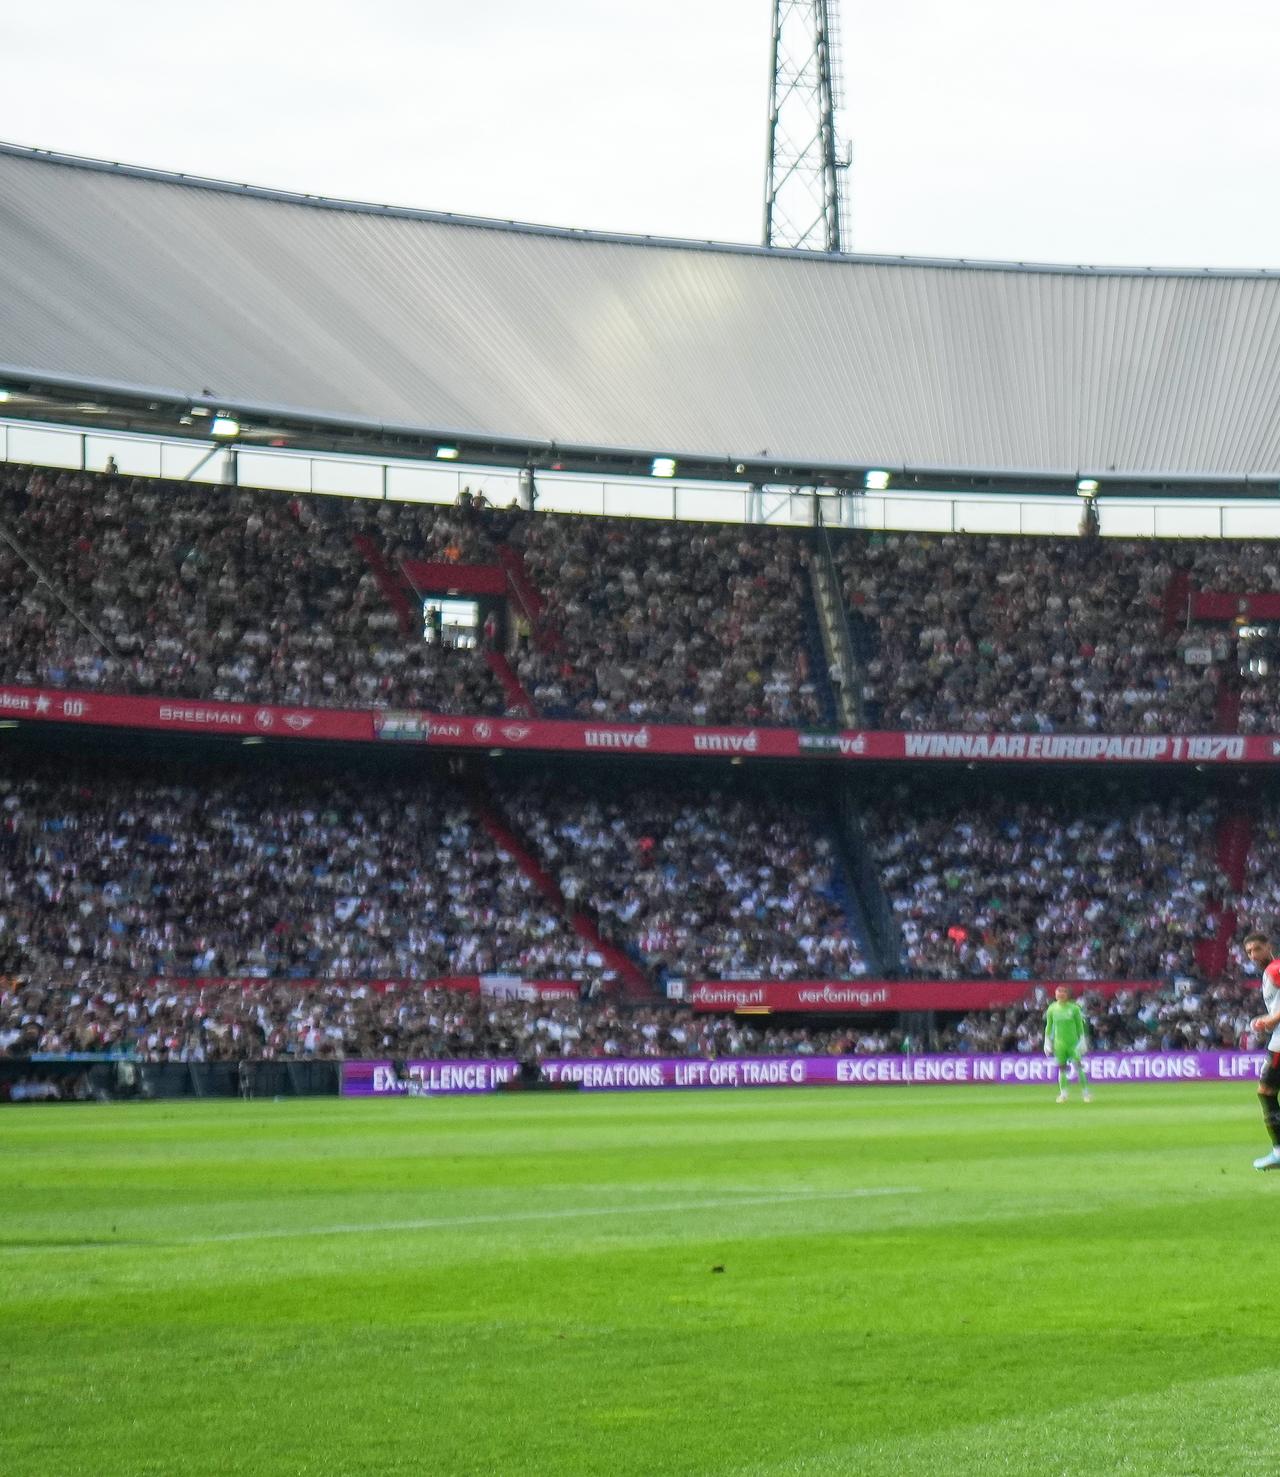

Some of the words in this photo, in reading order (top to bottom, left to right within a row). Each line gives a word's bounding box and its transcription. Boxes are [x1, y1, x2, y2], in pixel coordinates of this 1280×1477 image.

[160, 707, 242, 724] BREEMAN
[584, 728, 648, 748] univé
[693, 731, 757, 751] univé
[904, 735, 1026, 759] WINNAAR
[1026, 735, 1167, 759] EUROPACUP
[1186, 736, 1244, 760] 1970
[675, 1063, 706, 1085] LIFT
[709, 1063, 738, 1087] OFF,
[742, 1061, 788, 1084] TRADE
[836, 1059, 968, 1081] EXCELLENCE
[973, 1059, 996, 1080] IN
[1001, 1057, 1056, 1080] PORT
[1218, 1055, 1263, 1077] LIFT
[373, 1065, 486, 1091] EXELLENCE
